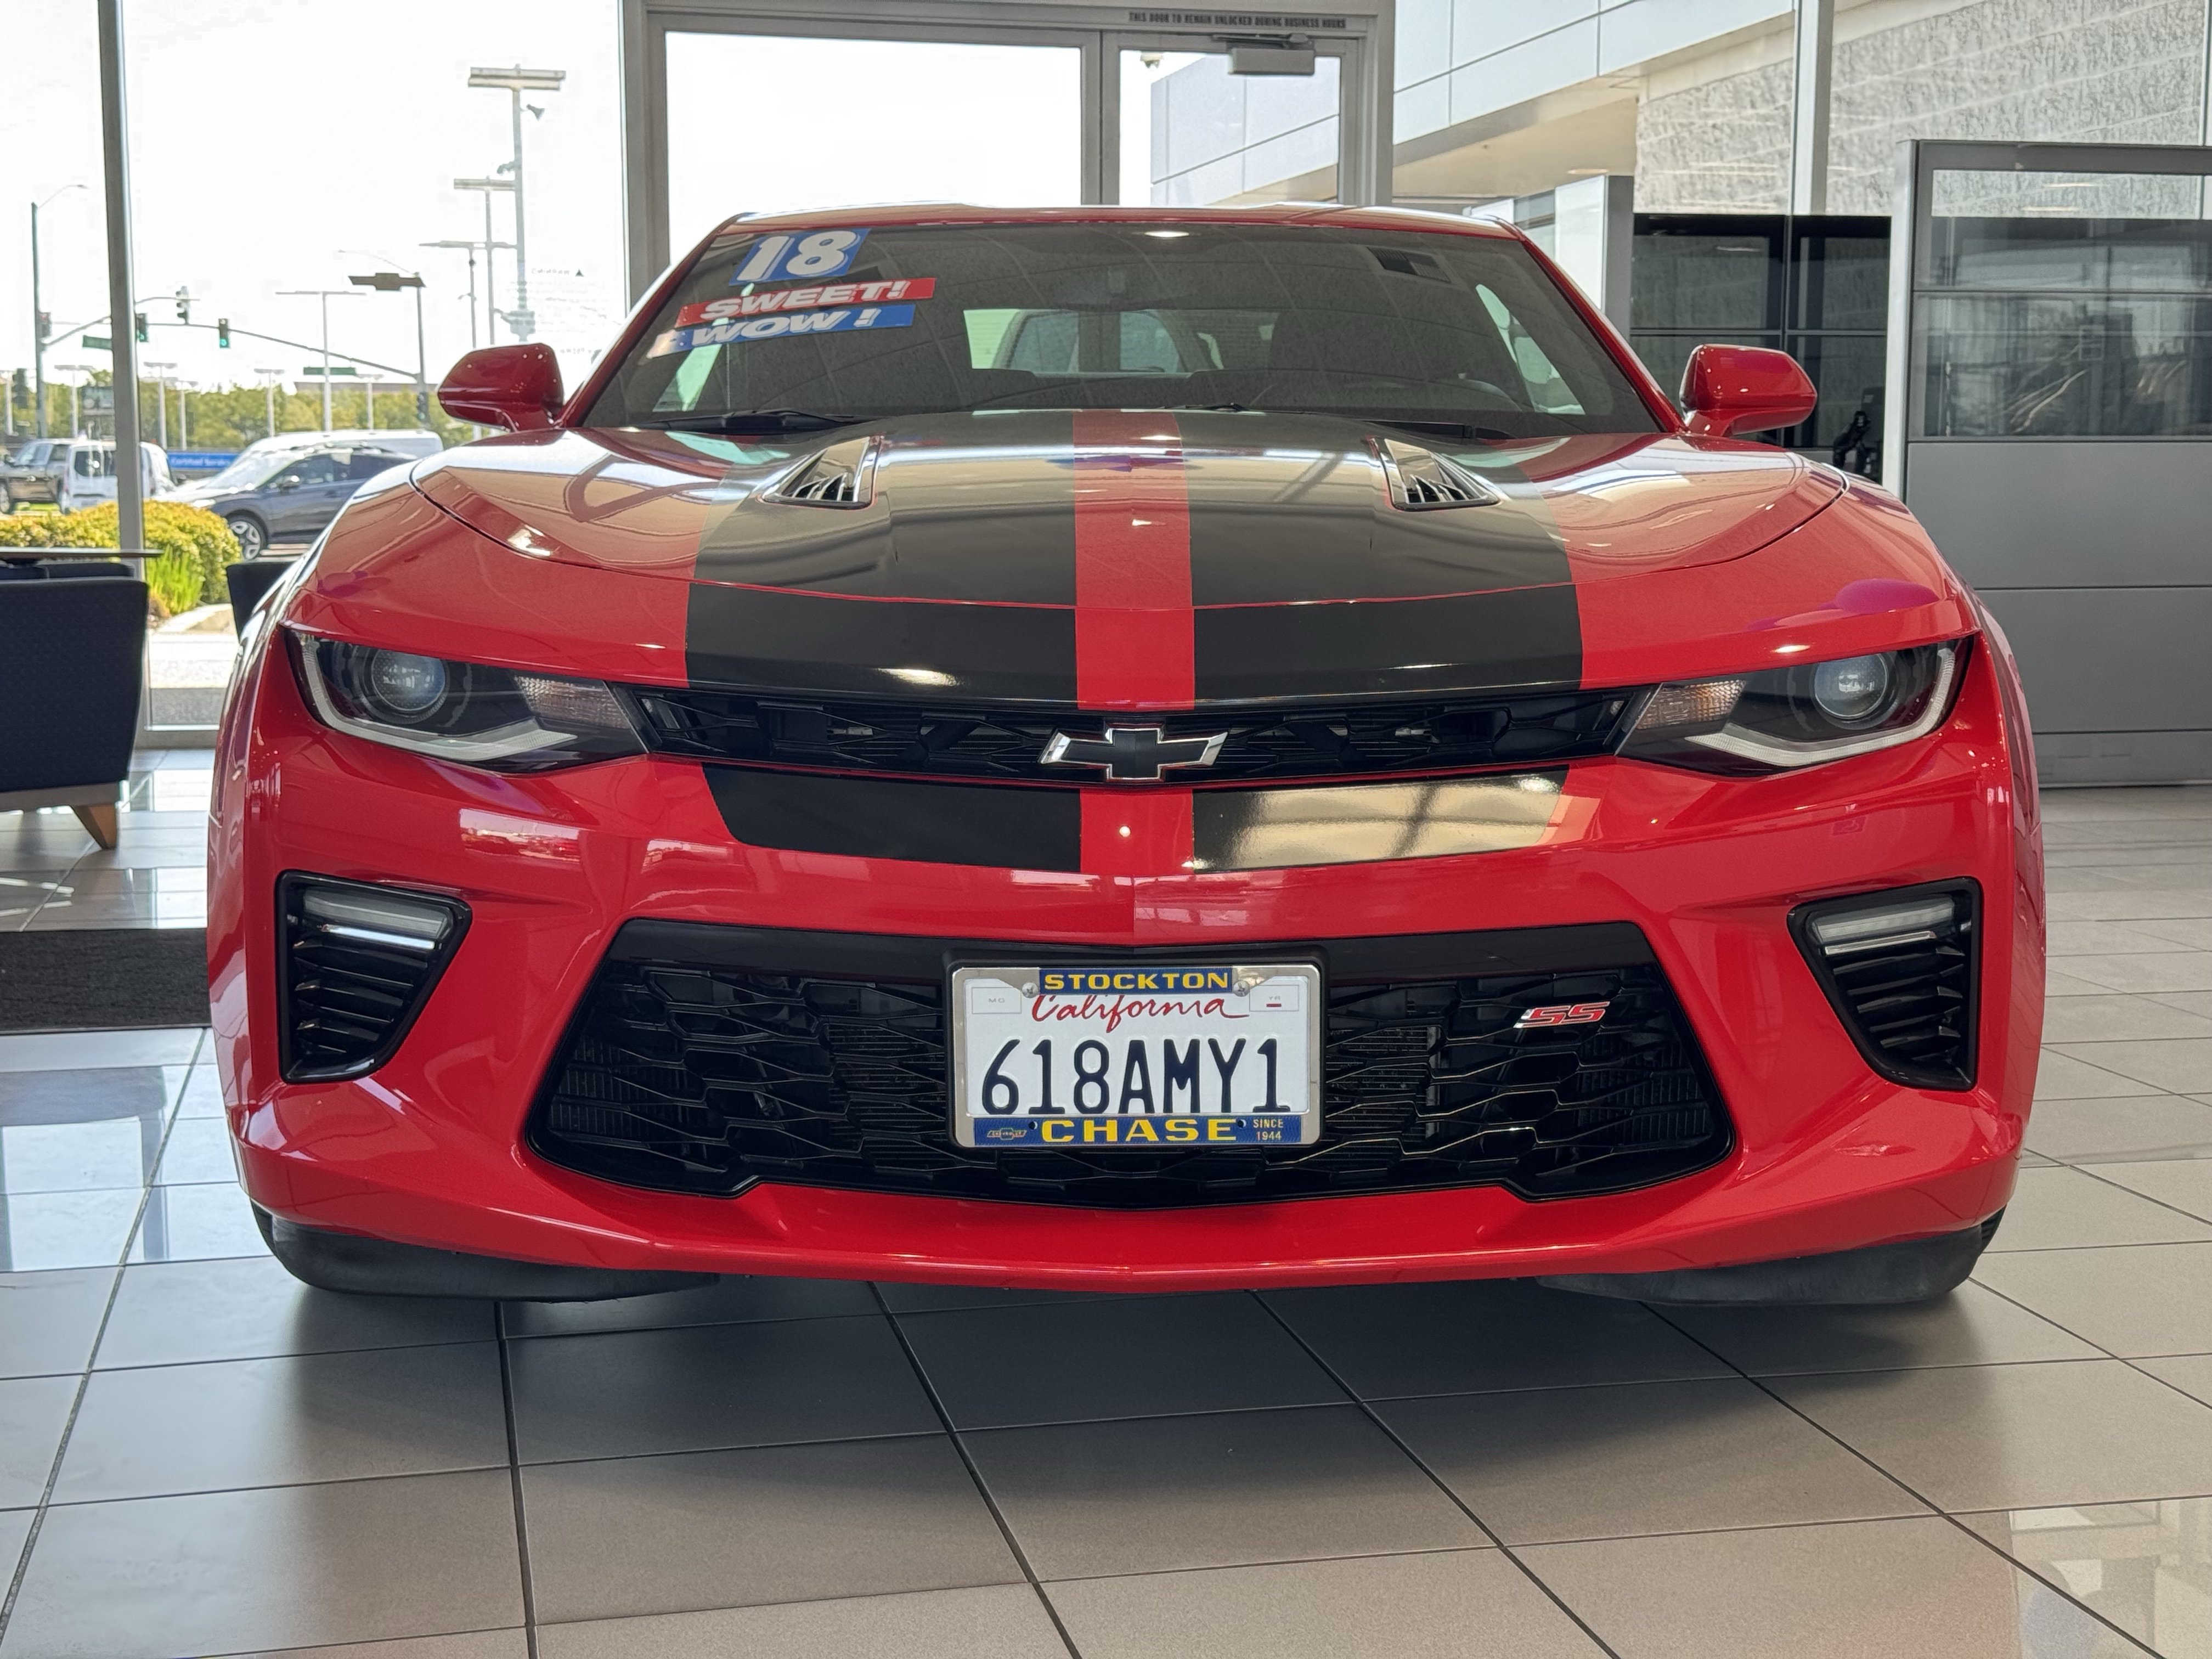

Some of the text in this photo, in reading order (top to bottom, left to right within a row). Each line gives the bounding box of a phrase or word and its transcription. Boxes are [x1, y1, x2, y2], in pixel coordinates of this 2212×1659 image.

[1129, 12, 1346, 28] THIS DOOR TO REMAIN UNLOCKED DURING BUSINESS HOURS
[737, 230, 861, 281] 18
[700, 281, 911, 319] SWEET!
[1044, 972, 1228, 991] STOCKTON
[1032, 994, 1250, 1033] California
[1513, 1001, 1610, 1028] SS
[981, 1038, 1291, 1115] 618AMY1
[1042, 1120, 1237, 1142] CHASE
[1253, 1119, 1284, 1128] SINCE
[1257, 1131, 1282, 1141] 1944
